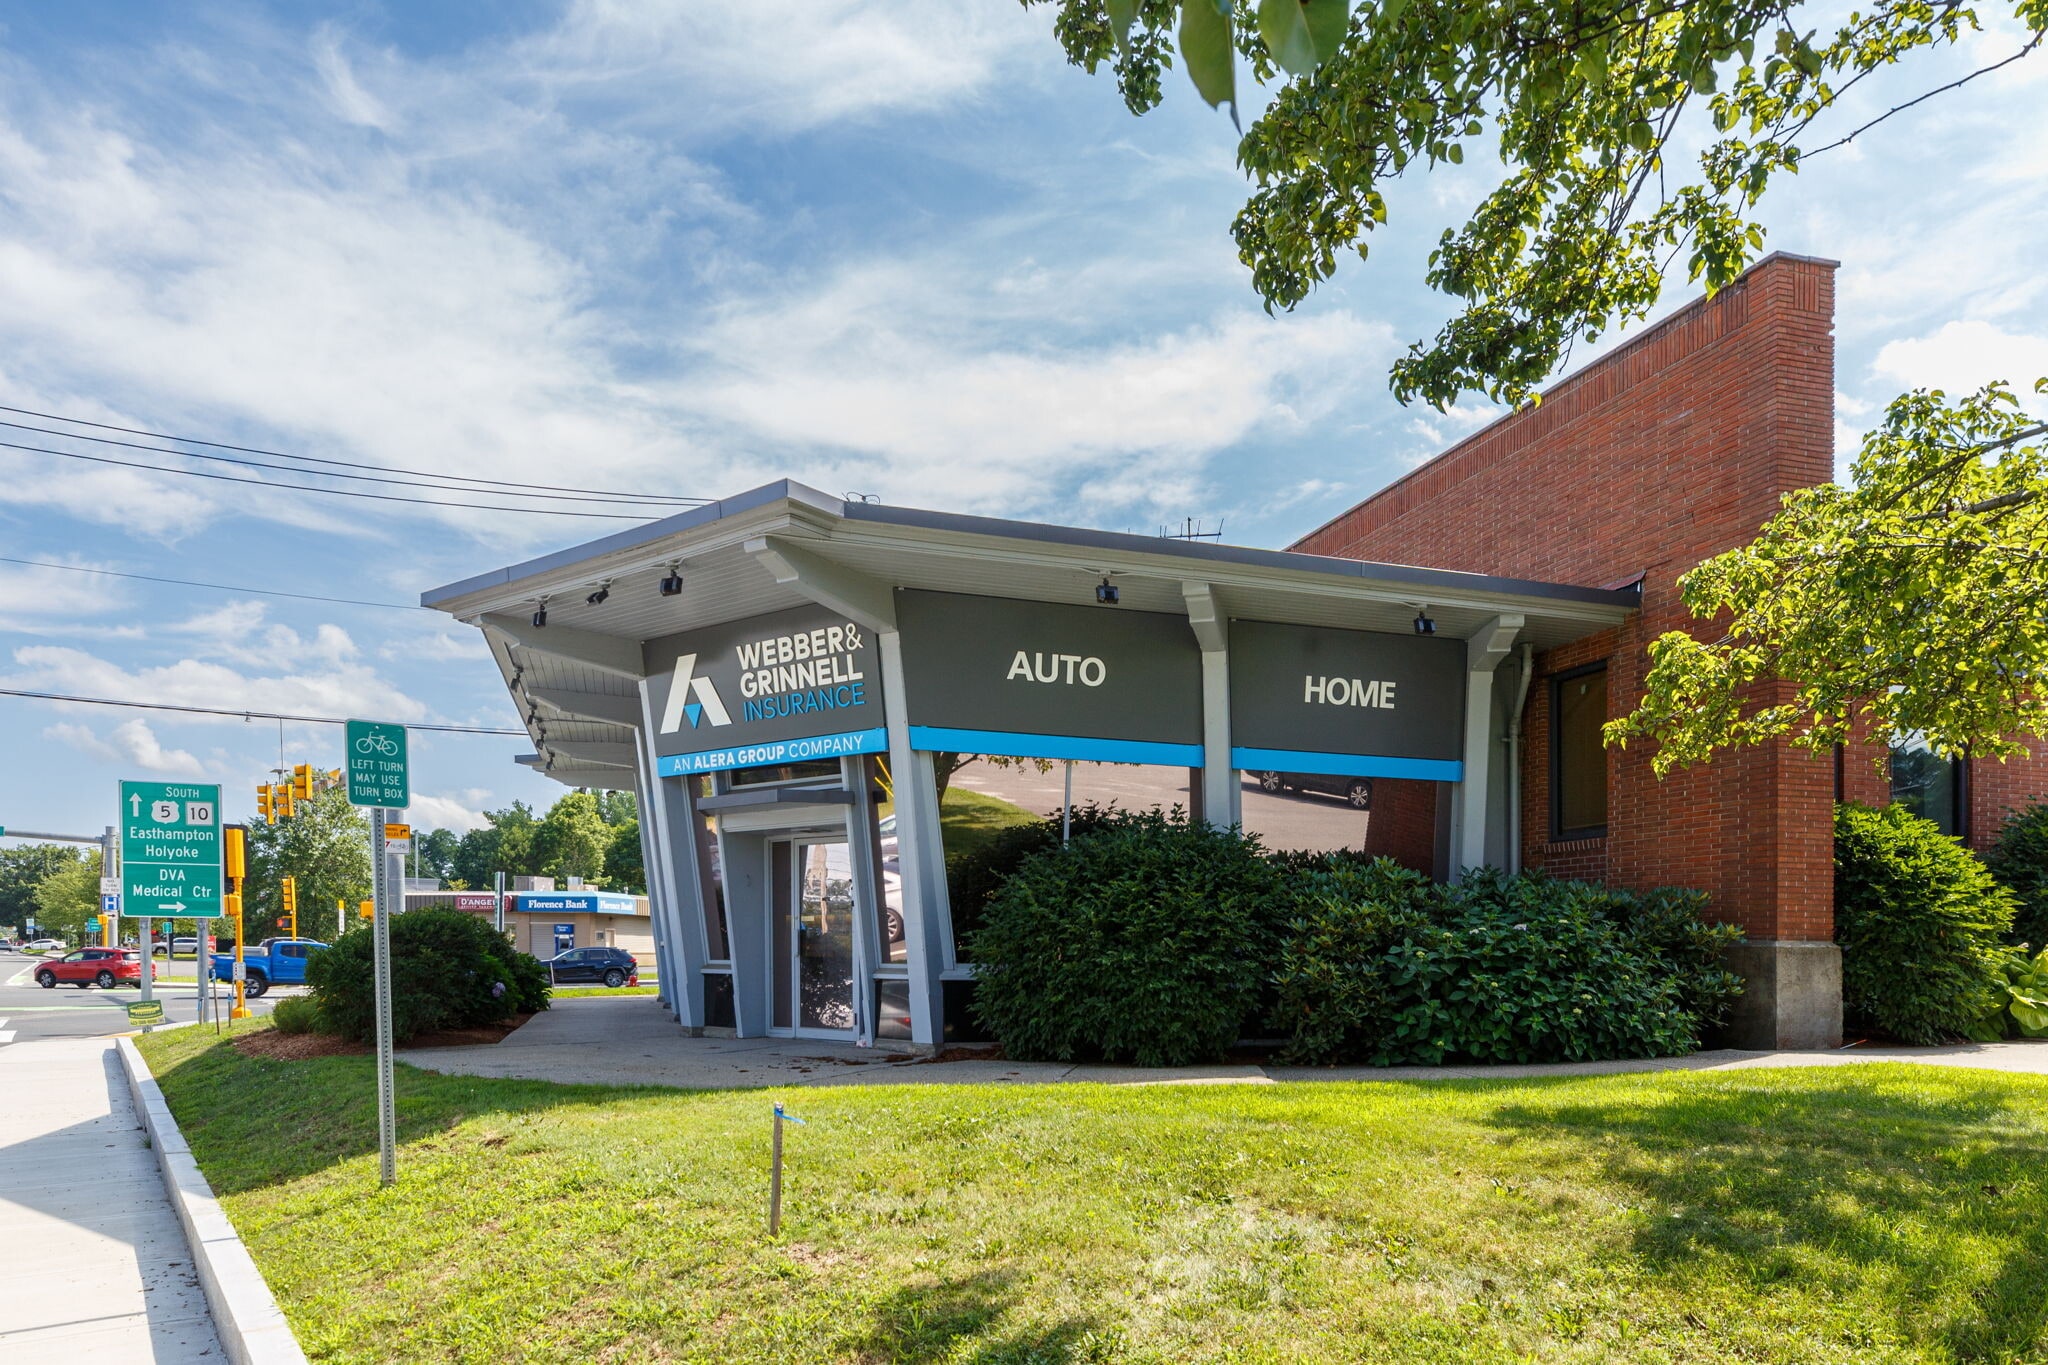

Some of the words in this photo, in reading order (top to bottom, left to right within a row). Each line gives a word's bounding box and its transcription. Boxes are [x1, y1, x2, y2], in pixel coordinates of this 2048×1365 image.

[740, 654, 864, 698] GRINNELL
[1006, 650, 1107, 688] AUTO
[1303, 675, 1397, 709] HOME
[743, 682, 866, 722] INSURANCE
[673, 758, 691, 773] AN
[694, 751, 735, 770] ALERA
[738, 745, 785, 764] GROUP
[789, 735, 864, 758] COMPANY
[351, 759, 375, 770] LEFT
[378, 761, 404, 772] TURN
[355, 772, 377, 783] MAY
[381, 774, 401, 785] USE
[165, 786, 200, 798] SOUTH
[354, 786, 380, 797] TURN
[384, 788, 404, 799] BOX
[161, 806, 171, 818] 5
[190, 807, 209, 821] 10
[130, 826, 214, 843] Easthampton
[145, 844, 199, 860] Holyoke
[160, 869, 186, 881] DVA
[133, 884, 182, 897] Medical
[192, 885, 212, 898] Ctr
[528, 899, 564, 909] Florence
[565, 899, 588, 909] Bank
